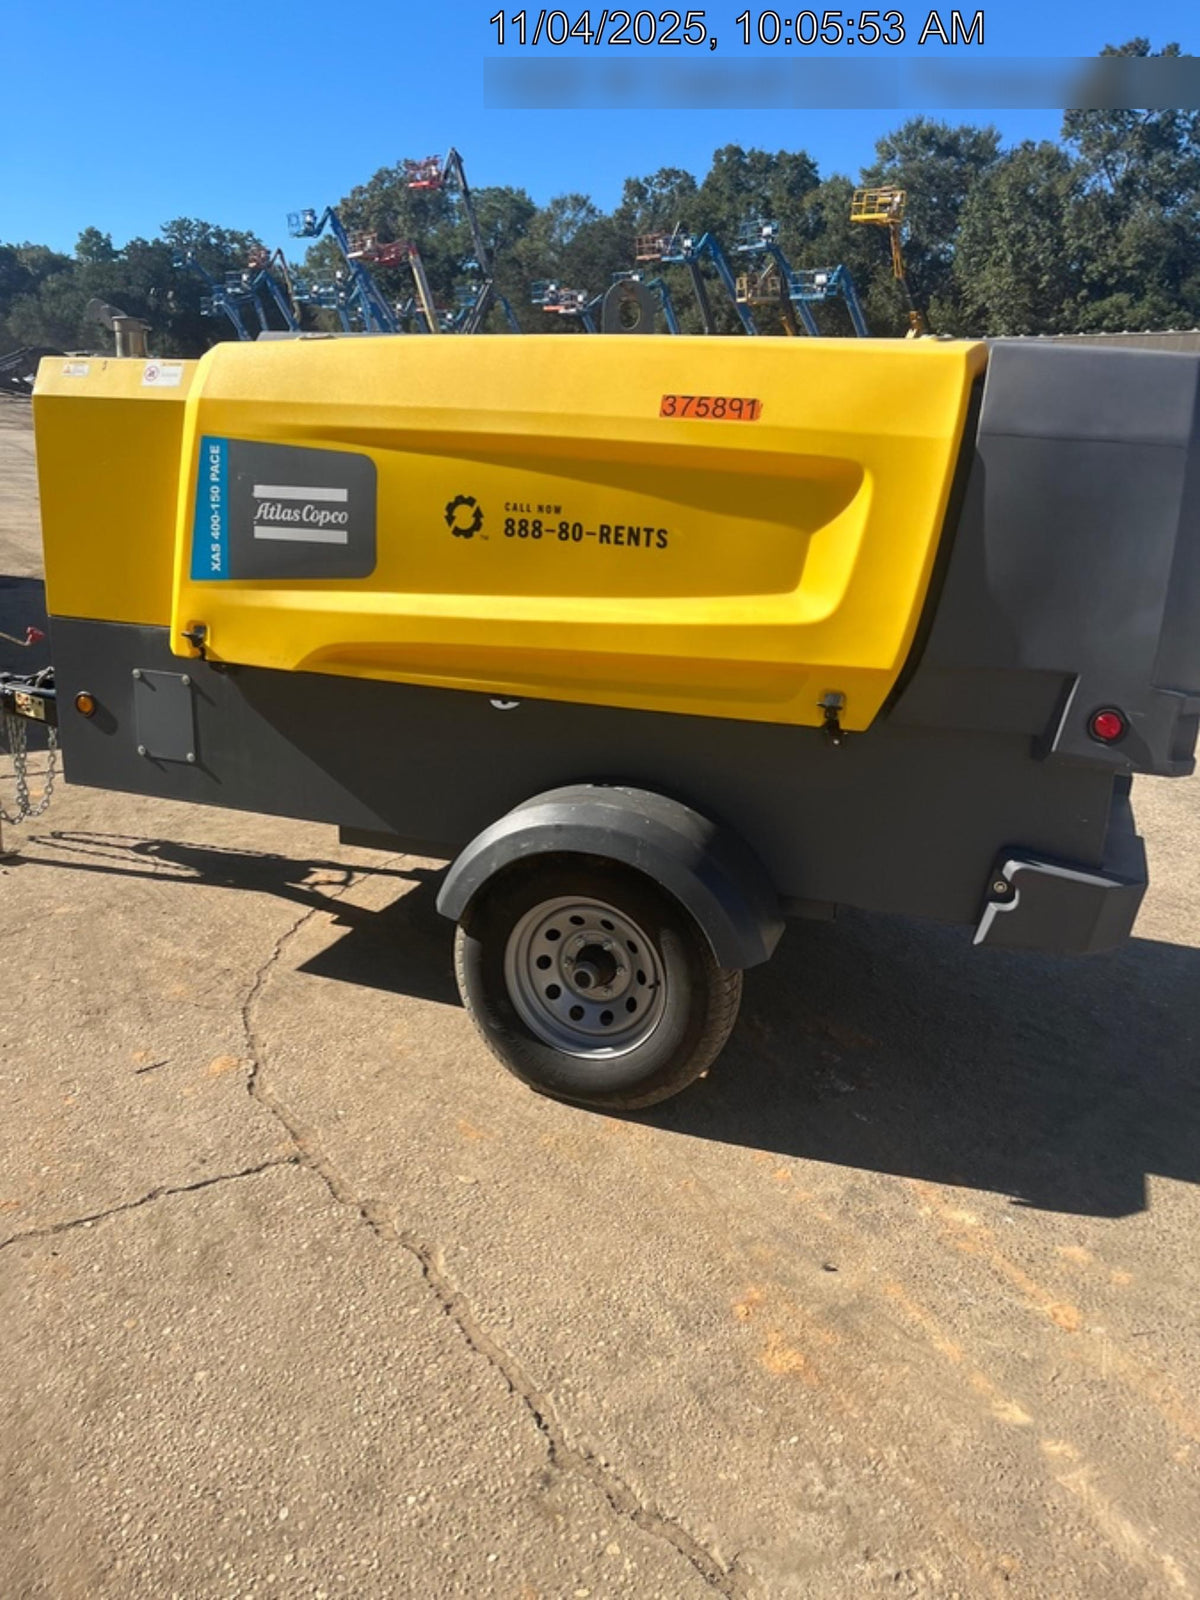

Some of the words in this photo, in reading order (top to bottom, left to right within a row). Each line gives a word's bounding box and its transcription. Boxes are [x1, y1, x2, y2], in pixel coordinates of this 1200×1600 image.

[662, 395, 757, 420] 375891
[208, 444, 220, 482] PACE
[209, 485, 220, 540] 400-150
[253, 502, 300, 522] Atlas
[301, 504, 349, 527] Copco
[504, 502, 533, 514] CALL
[537, 504, 562, 515] NOW
[503, 517, 669, 549] 888-80-RENTS
[210, 543, 221, 572] XAS
